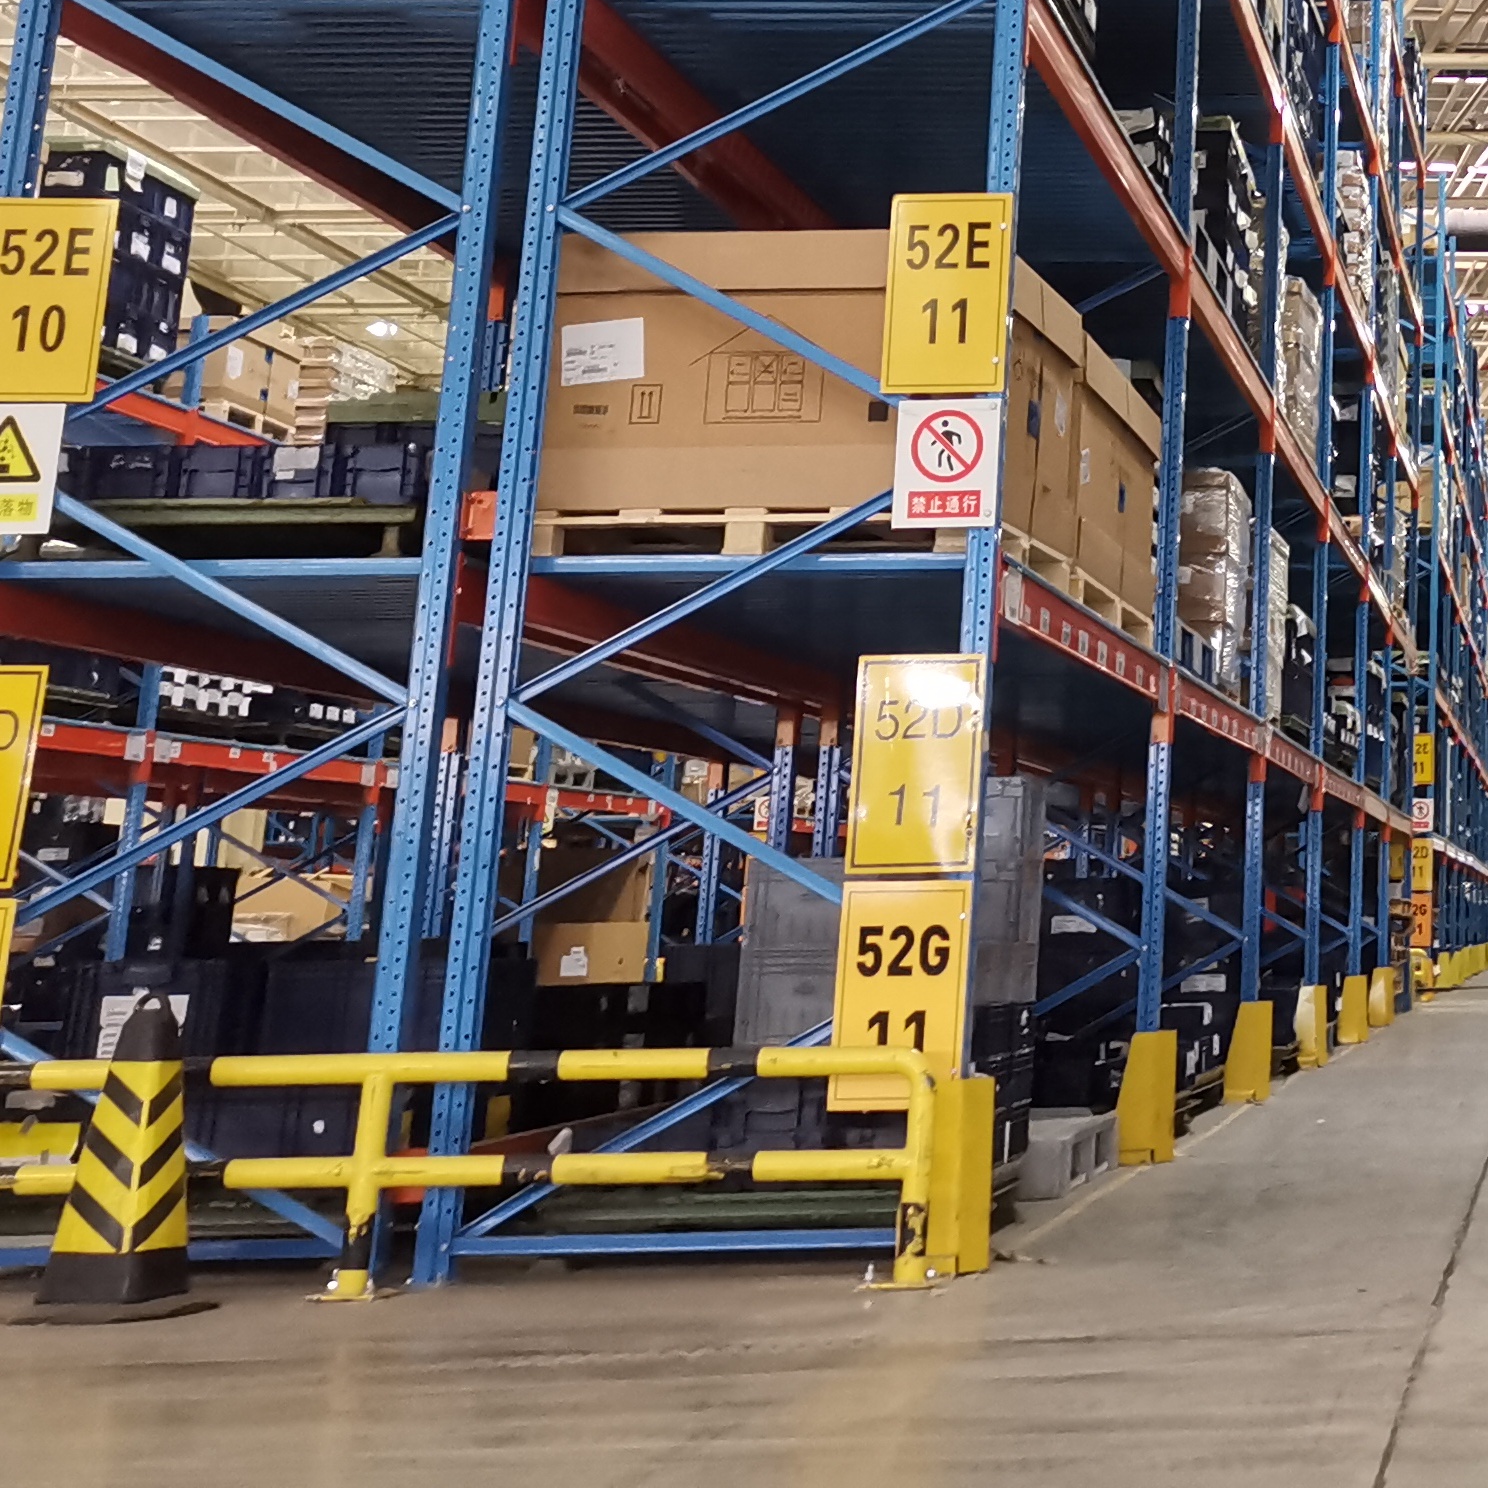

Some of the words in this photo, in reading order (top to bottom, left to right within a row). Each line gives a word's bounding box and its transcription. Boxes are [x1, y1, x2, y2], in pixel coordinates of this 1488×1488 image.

[0, 228, 95, 277] 52E
[906, 222, 992, 271] 52E
[12, 304, 66, 353] 10
[922, 297, 968, 345] 11
[911, 495, 977, 514] 禁止通行
[875, 699, 963, 741] 52D
[888, 783, 941, 826] 11
[856, 924, 950, 977] 52G
[867, 1010, 926, 1053] 11
